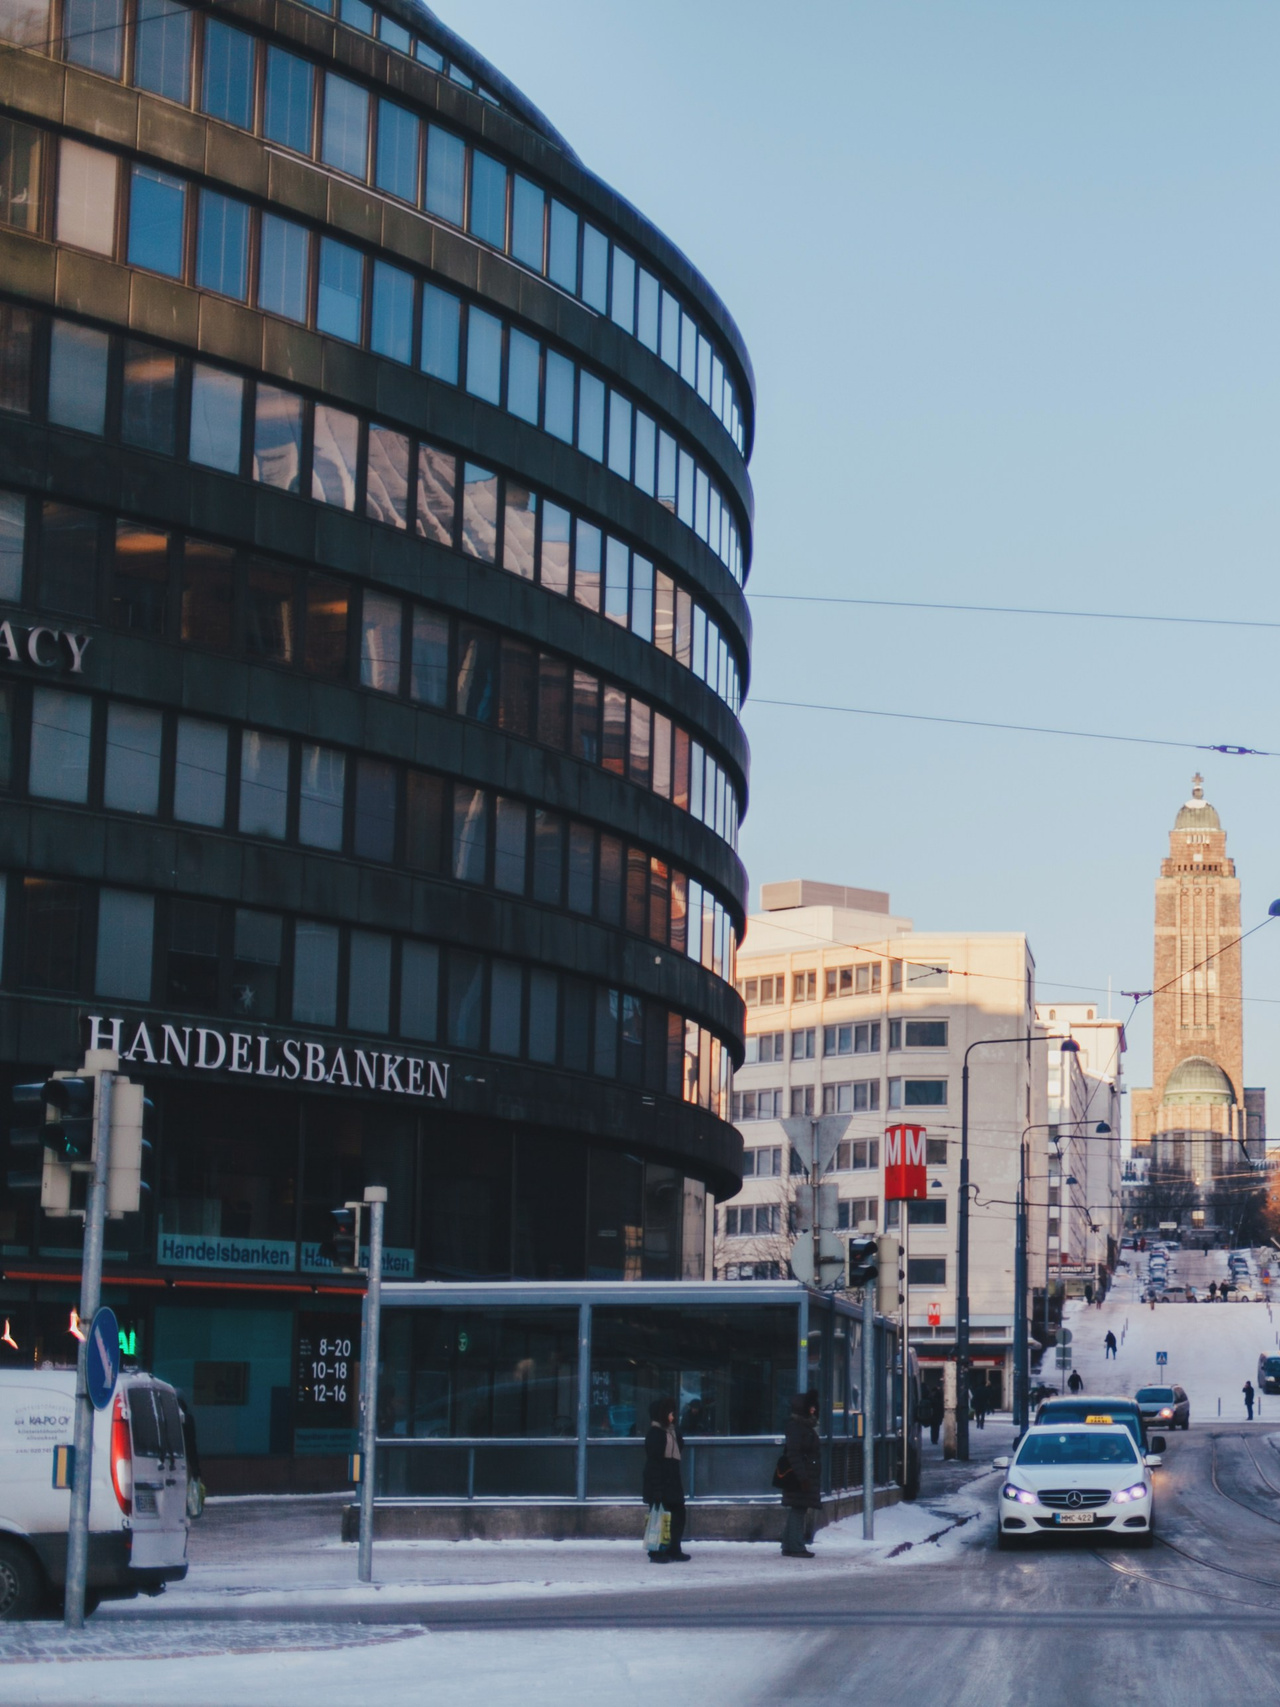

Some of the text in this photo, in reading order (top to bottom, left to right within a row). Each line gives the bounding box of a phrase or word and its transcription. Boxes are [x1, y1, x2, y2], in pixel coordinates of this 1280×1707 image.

[0, 620, 94, 674] ACY
[88, 1015, 450, 1100] HANDELSBANKEN
[905, 1129, 926, 1167] M
[162, 1239, 290, 1265] Handelsbanken
[929, 1304, 940, 1316] M
[312, 1361, 347, 1379] 10-18
[313, 1384, 347, 1402] 12-16
